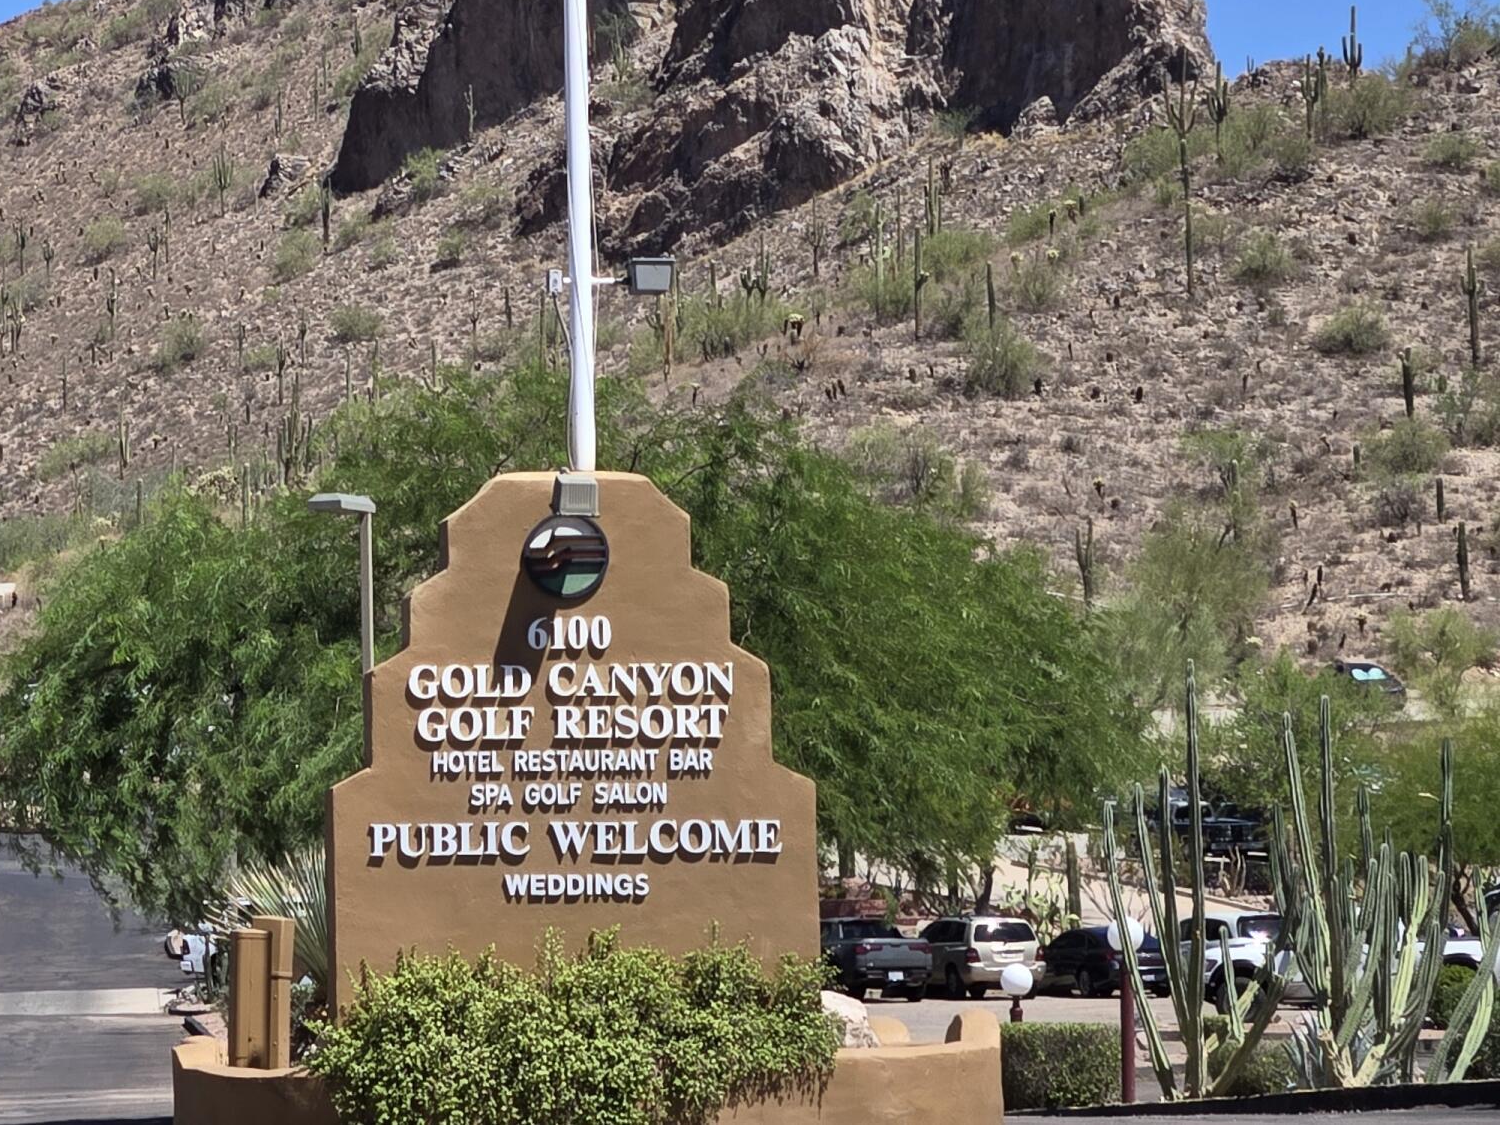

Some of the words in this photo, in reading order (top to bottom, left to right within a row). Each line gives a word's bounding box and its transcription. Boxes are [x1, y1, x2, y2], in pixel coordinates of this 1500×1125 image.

[527, 615, 612, 651] 6100
[408, 663, 532, 700] GOLD
[548, 661, 734, 698] CANYON
[417, 705, 535, 742] GOLF
[553, 703, 729, 740] RESORT
[432, 750, 505, 773] HOTEL
[513, 748, 660, 772] RESTAURANT
[669, 748, 713, 771] BAR
[470, 782, 514, 806] SPA
[524, 782, 583, 806] GOLF
[594, 781, 668, 805] SALON
[369, 821, 531, 858] PUBLIC
[548, 818, 783, 856] WELCOME
[504, 872, 650, 896] WEDDINGS
